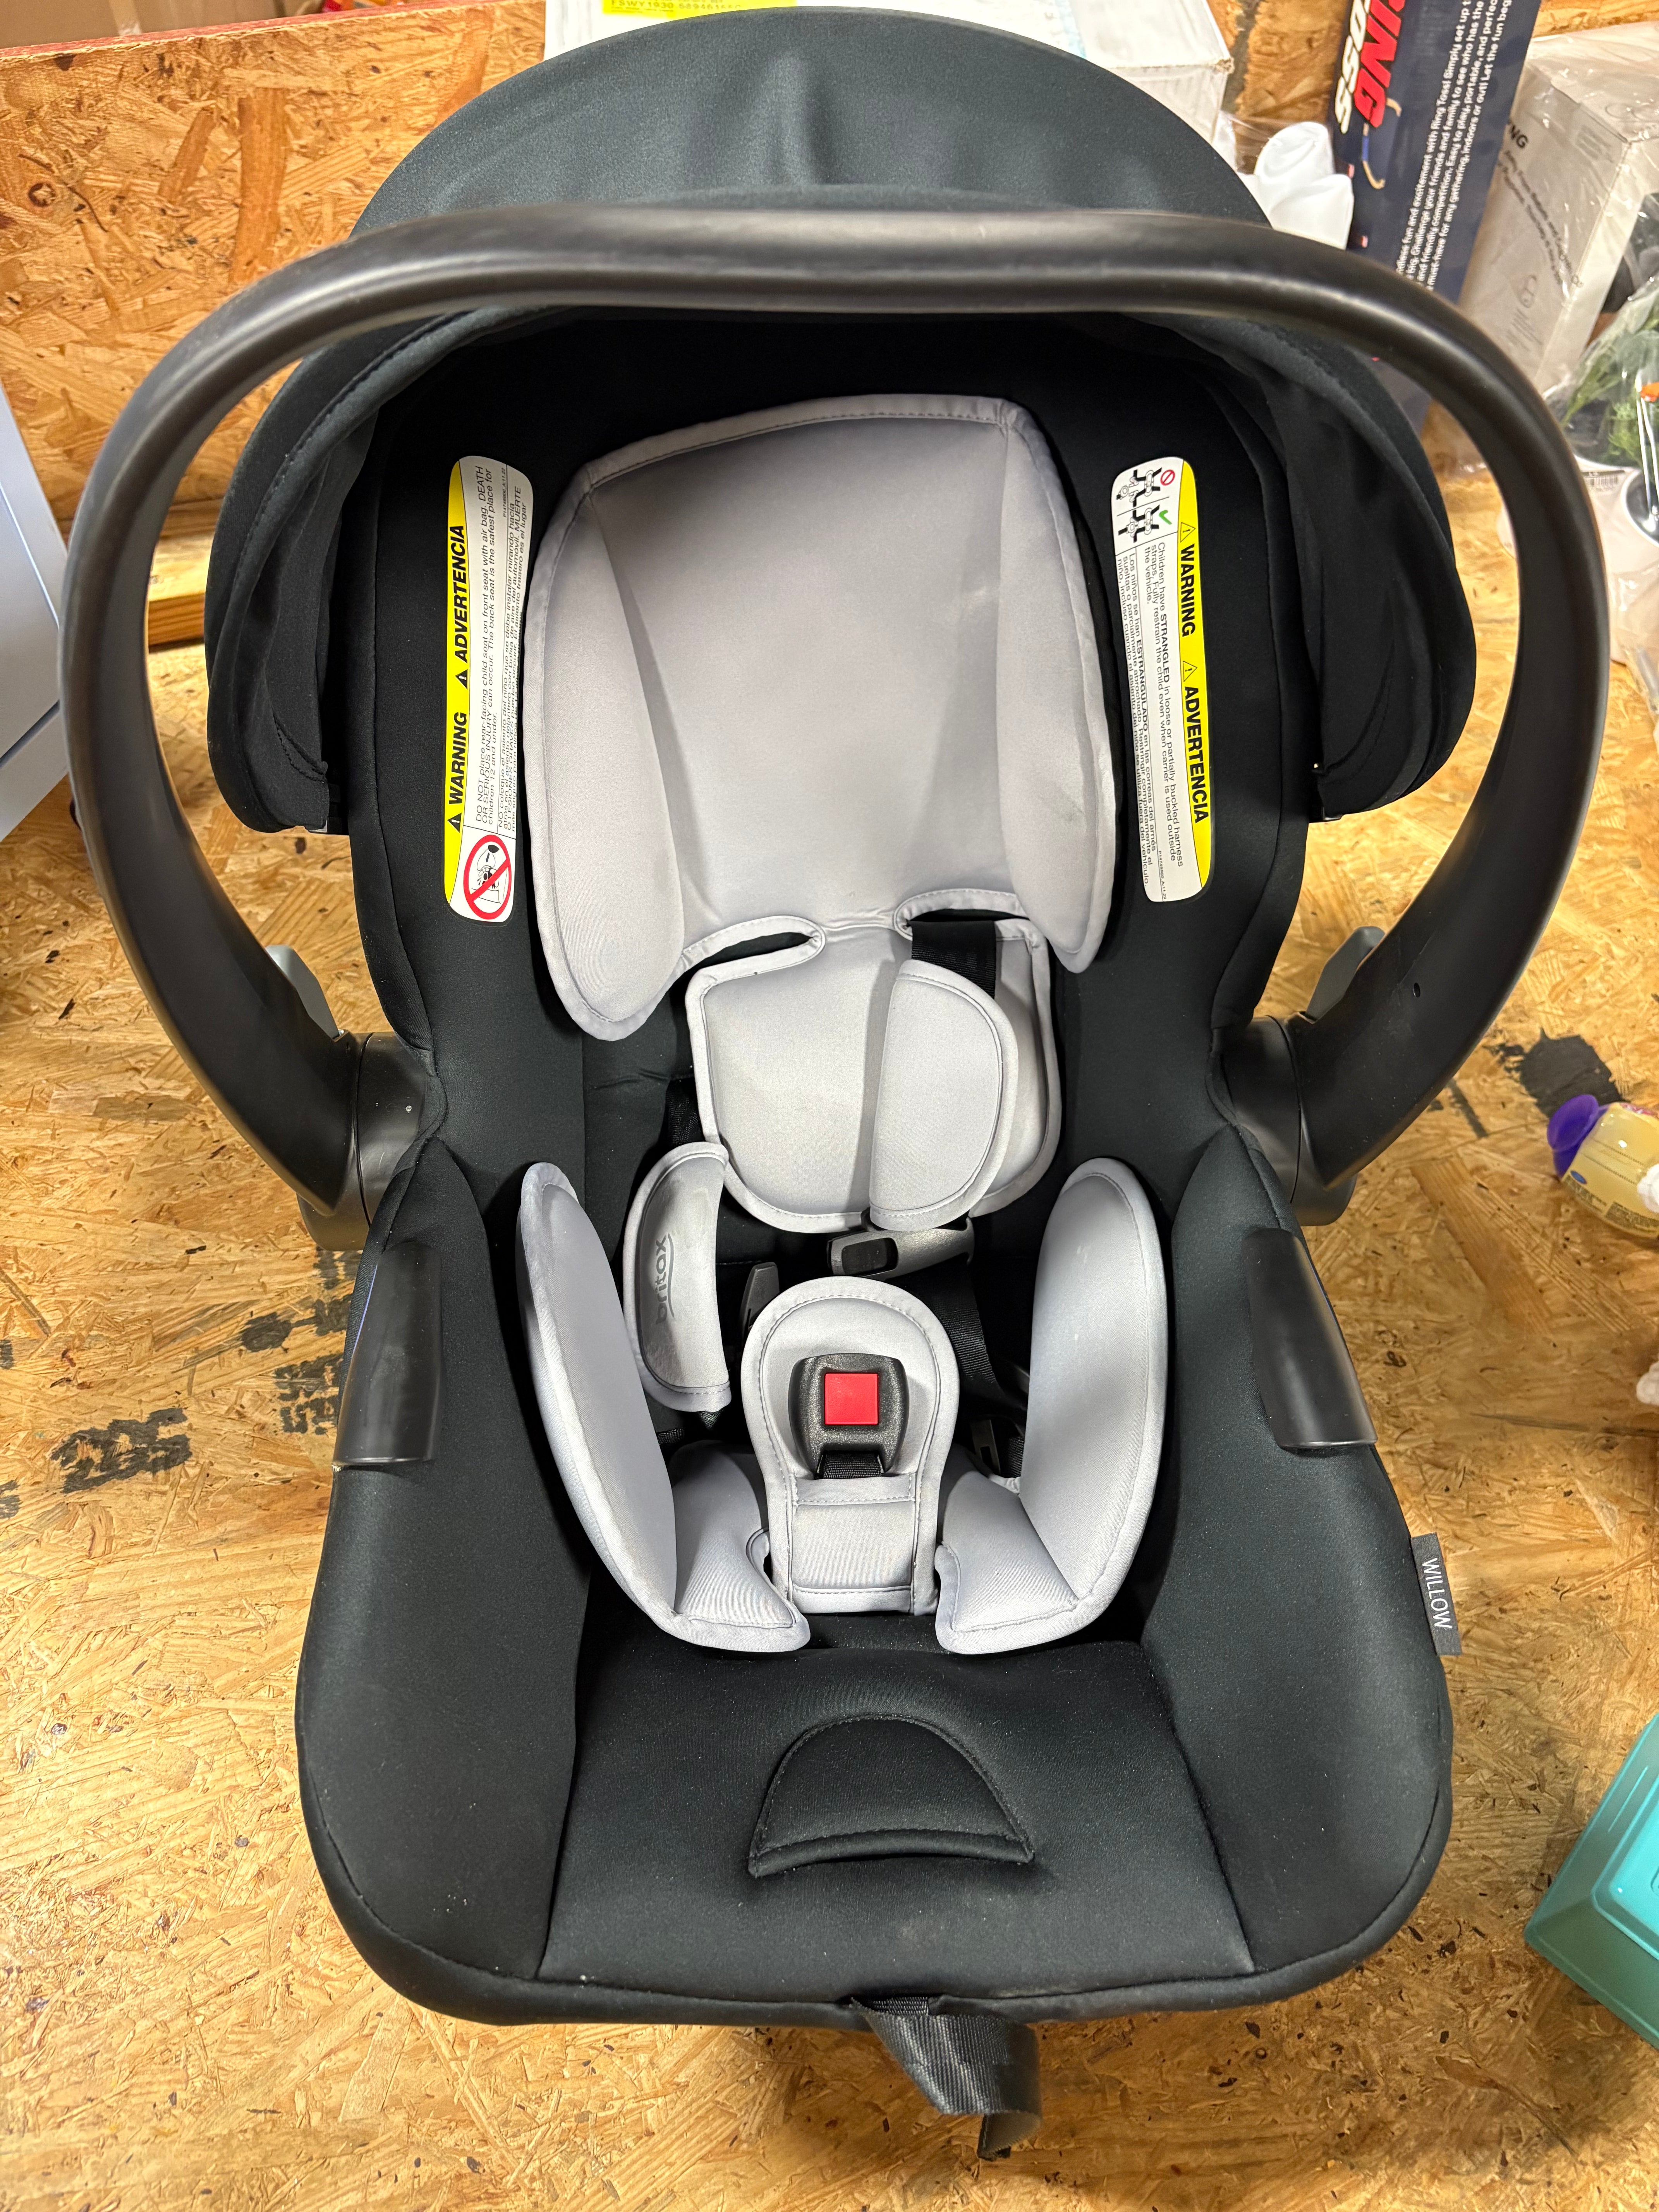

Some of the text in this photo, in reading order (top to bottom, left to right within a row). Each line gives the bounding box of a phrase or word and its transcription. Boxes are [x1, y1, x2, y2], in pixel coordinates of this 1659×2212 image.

[1460, 8, 1470, 22] up
[1455, 25, 1465, 42] set
[1491, 23, 1504, 41] fun
[1443, 44, 1462, 79] Simply
[1486, 44, 1498, 62] the
[1334, 0, 1372, 134] OSS
[1480, 64, 1493, 81] Let
[1431, 107, 1446, 129] Ring
[1473, 105, 1481, 115] or
[1410, 1, 1484, 255] Challenge your friends and family to see who has the
[1420, 227, 1439, 263] friendly
[1445, 143, 1461, 166] Easy
[1453, 131, 1463, 142] to
[1477, 36, 1488, 56] and
[1427, 131, 1438, 153] with
[1413, 154, 1432, 207] excitement
[1408, 208, 1419, 226] and
[1444, 204, 1457, 222] any
[1402, 227, 1414, 243] fun
[1439, 223, 1450, 237] for
[476, 465, 486, 501] DEATH
[480, 505, 488, 526] bag.
[519, 531, 524, 539] el
[519, 542, 524, 553] es
[449, 525, 467, 663] ADVERTENCIA
[1180, 544, 1195, 637] WARNING
[483, 620, 488, 632] on
[1123, 623, 1132, 660] cuando
[1160, 614, 1169, 683] STRANGLED
[483, 807, 488, 823] OR
[488, 485, 496, 513] place
[1133, 604, 1138, 616] se
[1136, 639, 1147, 731] ESTRANGULADO
[1144, 735, 1148, 747] en
[1164, 686, 1170, 695] in
[1127, 604, 1137, 666] parcialmente
[1140, 778, 1151, 854] completamente
[1147, 857, 1152, 865] el
[1166, 728, 1171, 738] or
[448, 712, 467, 804] WARNING
[500, 756, 505, 765] el
[1165, 742, 1175, 781] partially
[1184, 686, 1208, 823] ADVERTENCIA
[490, 769, 495, 780] 12
[1164, 786, 1171, 794] is
[476, 805, 482, 821] DO
[1170, 784, 1179, 824] buckled
[498, 811, 503, 827] NO
[1167, 824, 1176, 861] outside
[1173, 827, 1183, 867] harness
[656, 1235, 667, 1325] britax
[1422, 1557, 1453, 1628] WILLOW
